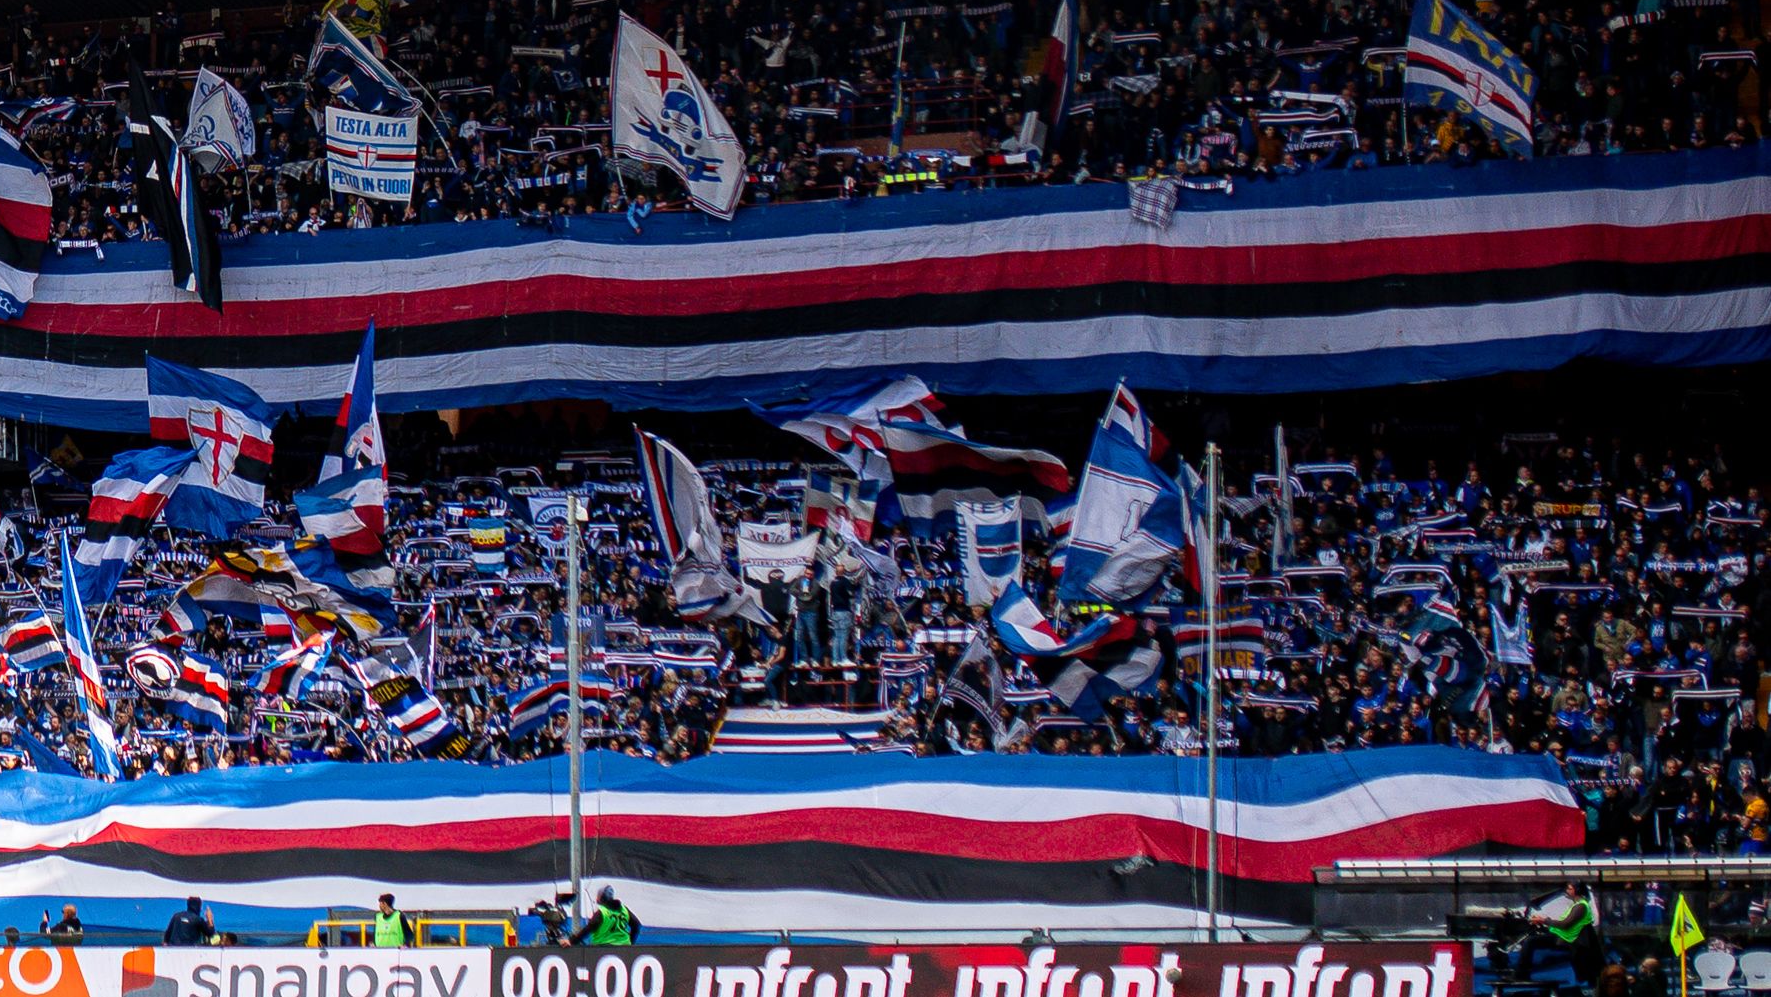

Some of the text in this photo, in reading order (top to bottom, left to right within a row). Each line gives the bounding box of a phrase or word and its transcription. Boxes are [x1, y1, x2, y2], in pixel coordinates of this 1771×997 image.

[335, 116, 407, 138] TESTA ALTA
[332, 169, 411, 194] PETTO IN FUORI
[189, 950, 468, 997] snaipay
[502, 955, 665, 997] 00:00
